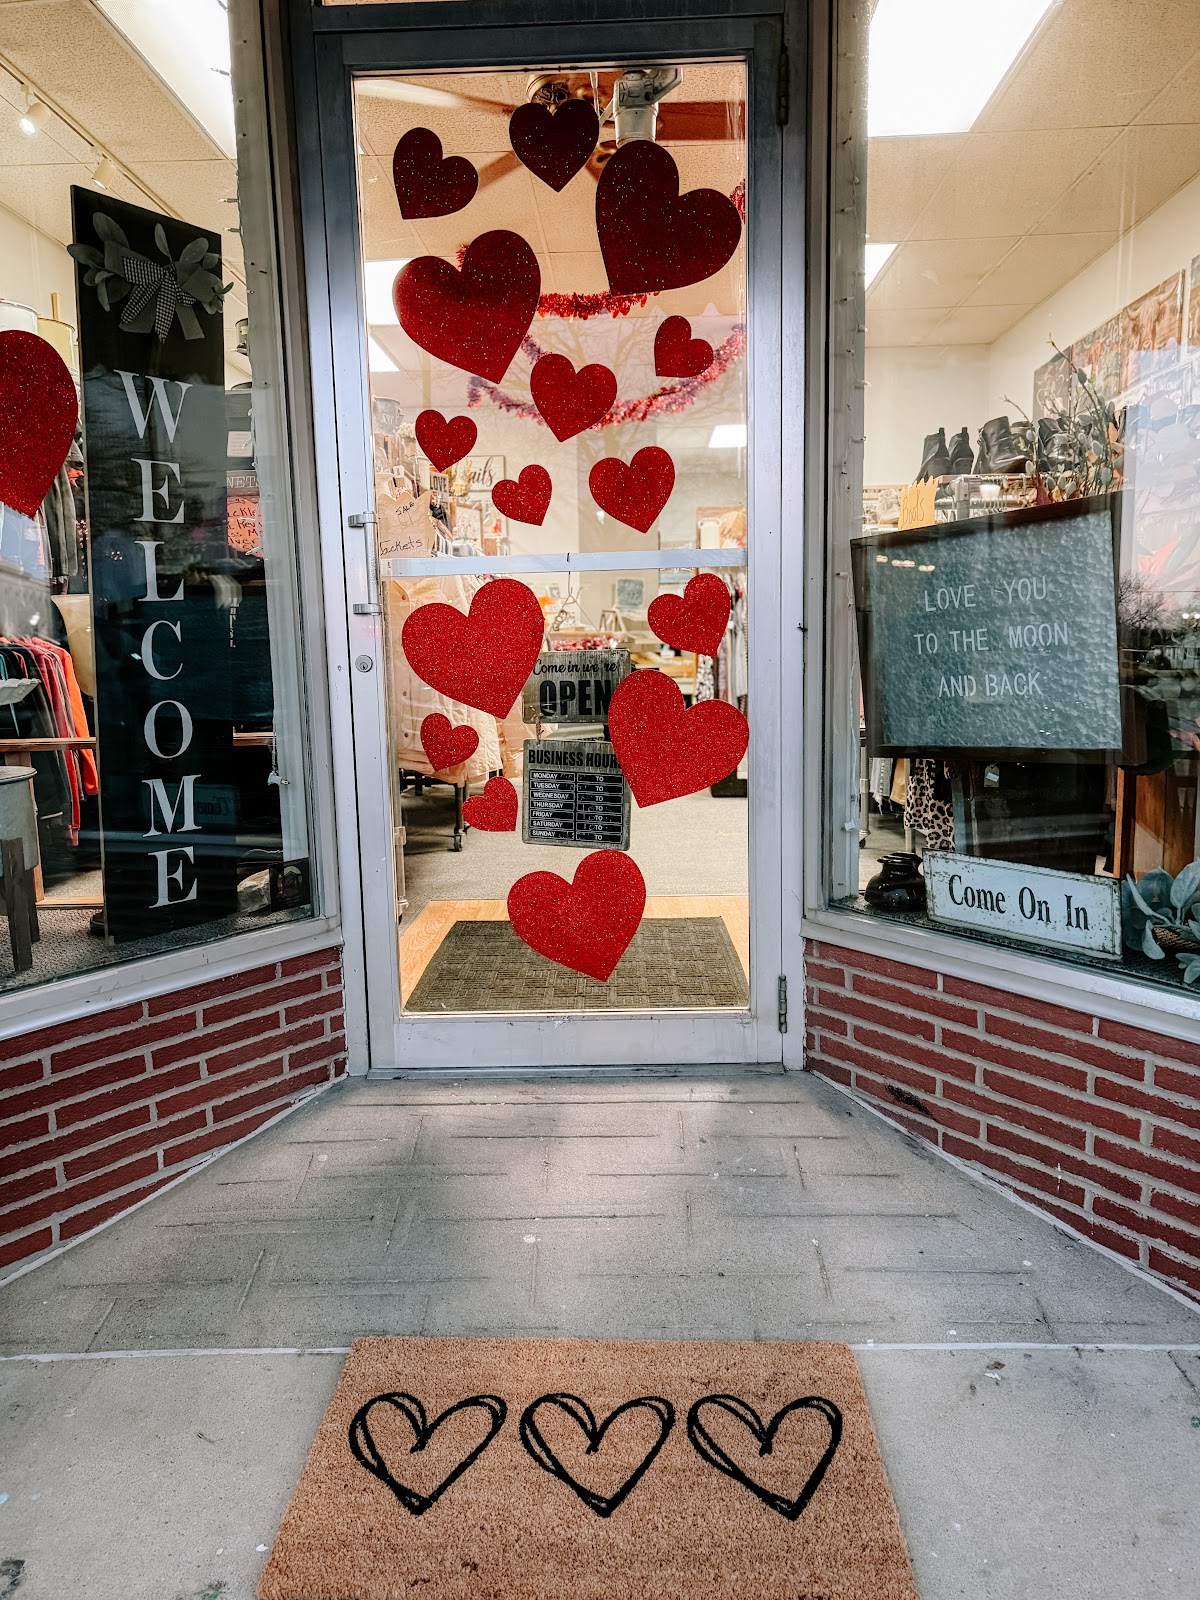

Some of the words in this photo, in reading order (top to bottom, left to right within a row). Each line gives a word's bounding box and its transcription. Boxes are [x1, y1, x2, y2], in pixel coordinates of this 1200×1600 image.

[430, 475, 447, 493] LOVE
[924, 584, 977, 612] LOVE
[1003, 576, 1048, 604] YOU
[113, 368, 202, 909] WELCOME
[914, 632, 938, 655] TO
[949, 628, 989, 652] THE
[1008, 622, 1069, 649] MOON
[532, 659, 566, 676] Come
[567, 661, 580, 674] in
[540, 680, 611, 716] OPEN
[938, 675, 977, 698] AND
[985, 671, 1042, 696] BACK
[528, 749, 583, 767] BUSINESS
[585, 753, 621, 769] HOUR
[533, 792, 569, 800] WEDNESDAY
[532, 820, 563, 828] SATURDAY
[948, 874, 1006, 914] Come
[1018, 886, 1051, 923] On
[1064, 894, 1090, 931] In
